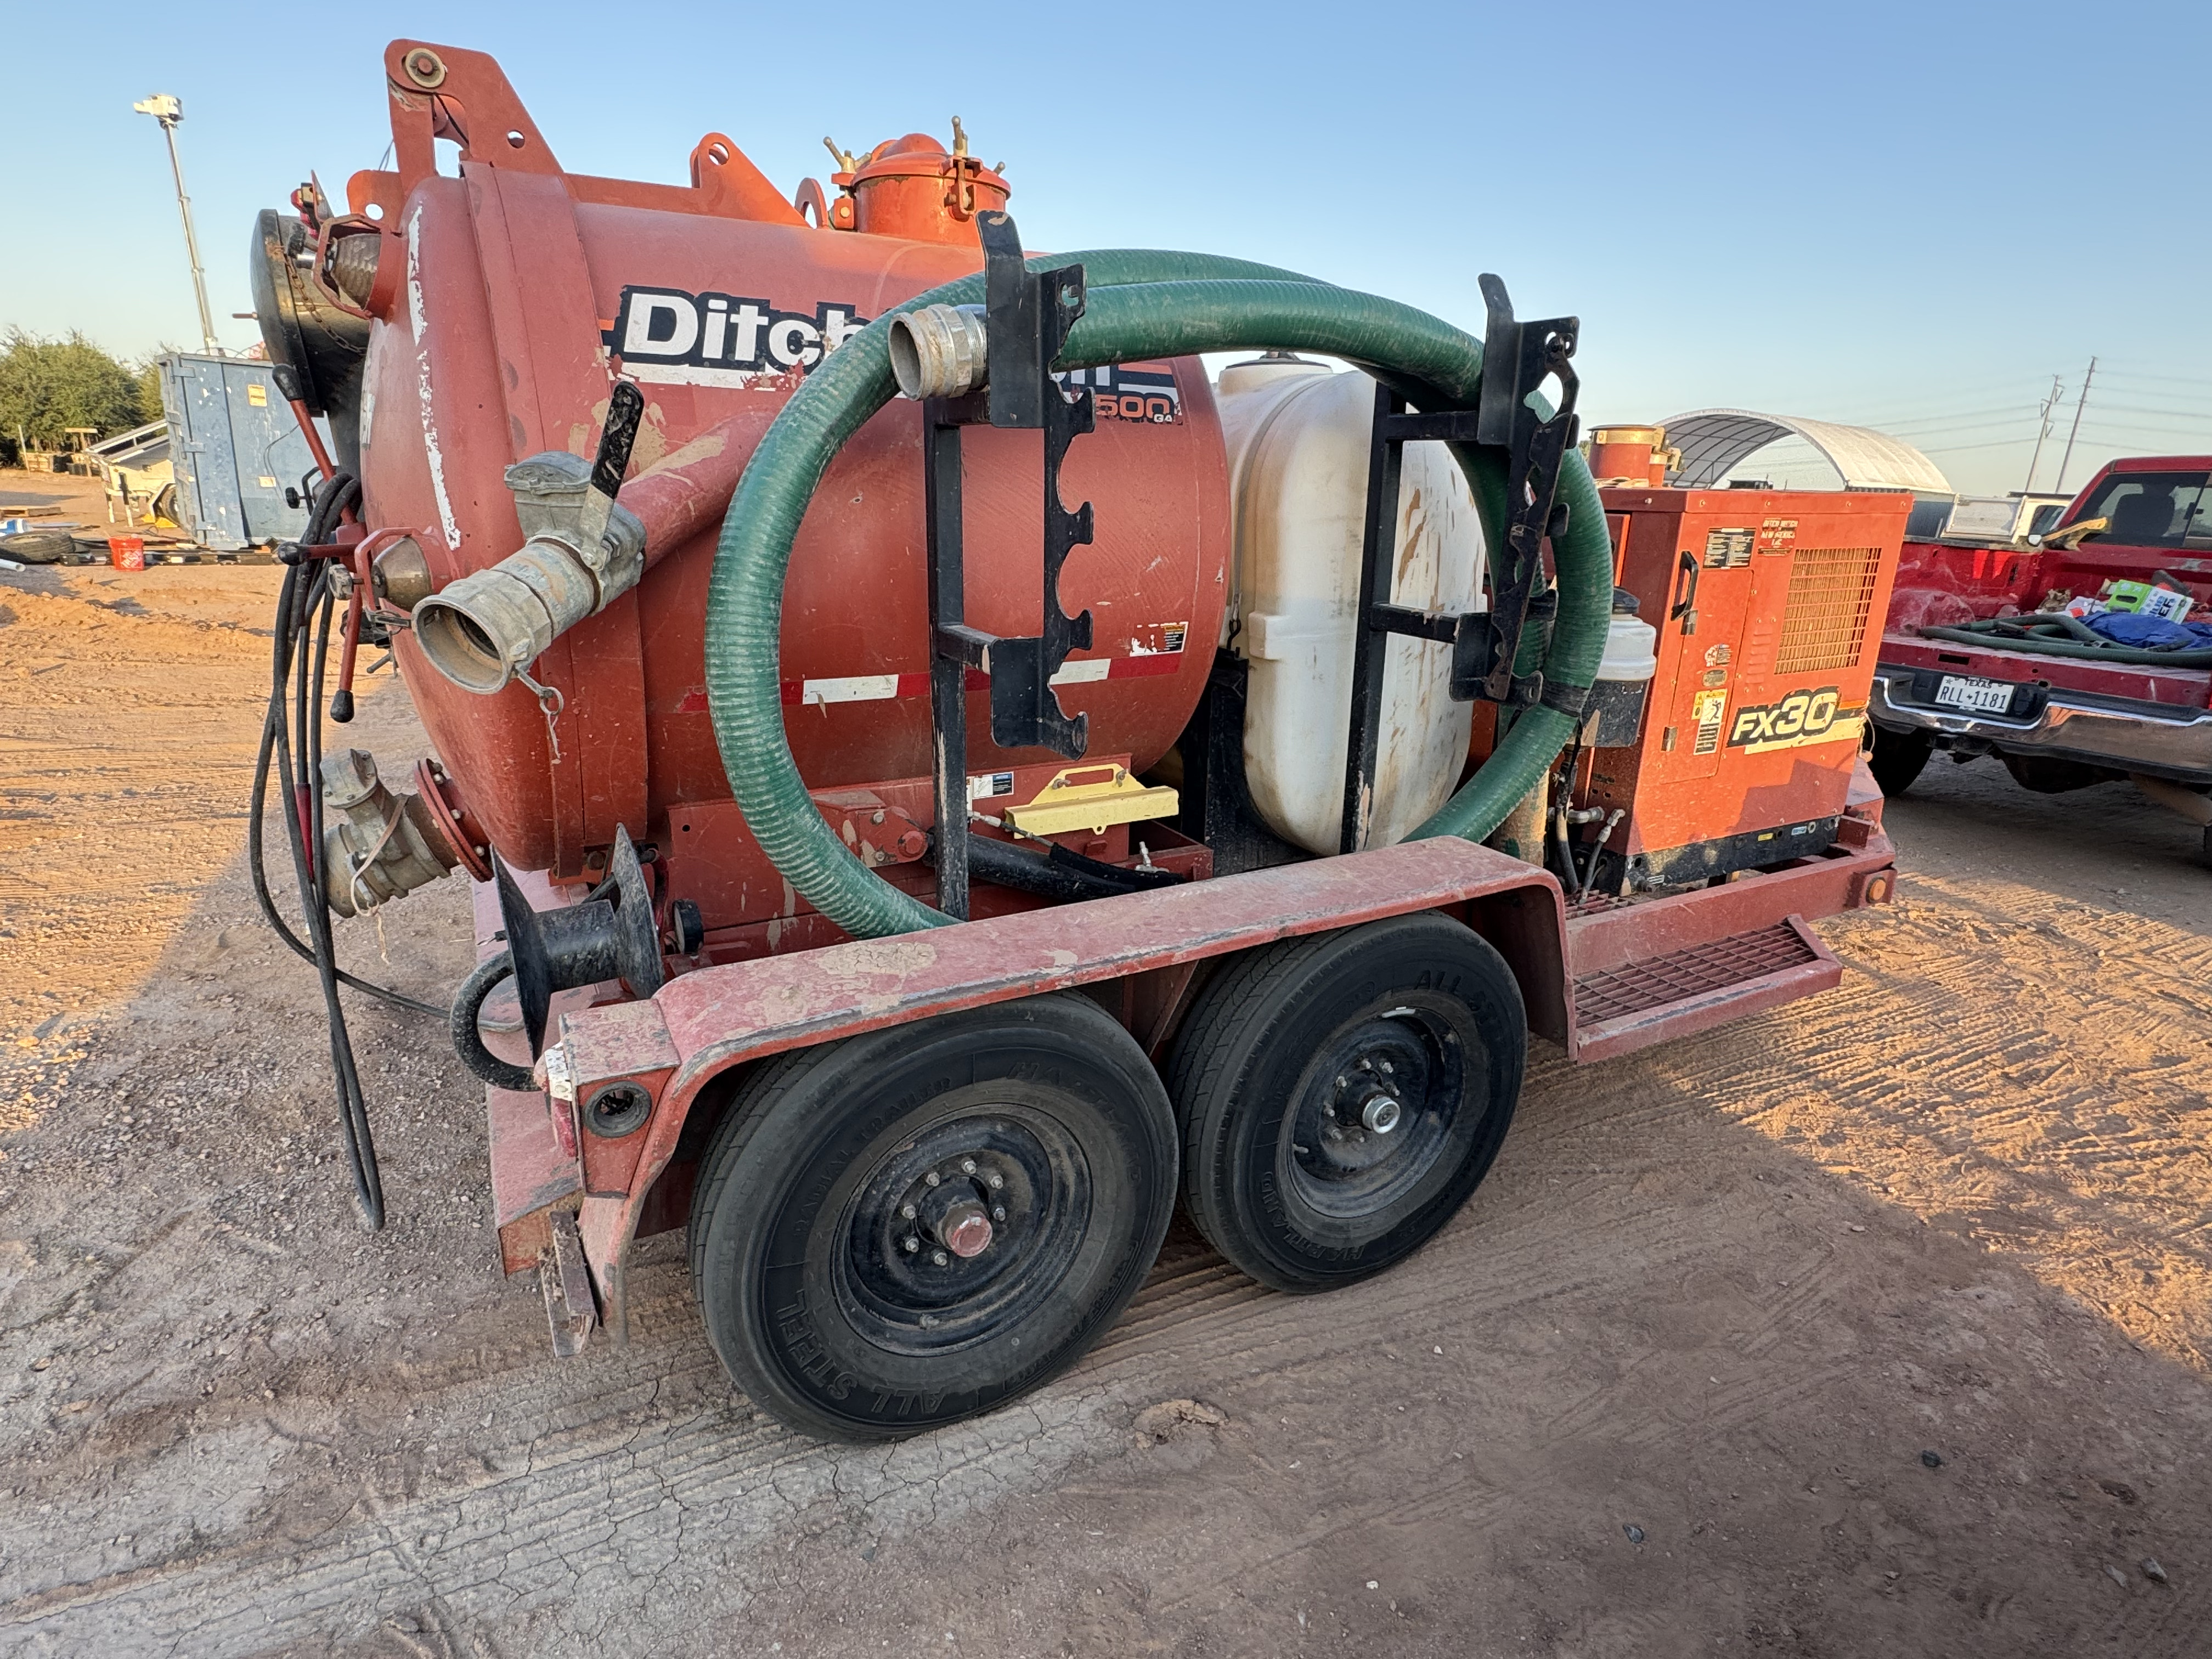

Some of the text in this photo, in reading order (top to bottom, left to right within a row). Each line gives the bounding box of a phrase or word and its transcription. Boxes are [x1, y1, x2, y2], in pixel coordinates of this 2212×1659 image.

[1732, 692, 1838, 741] FX30
[775, 1289, 947, 1417] ALL STEEL
